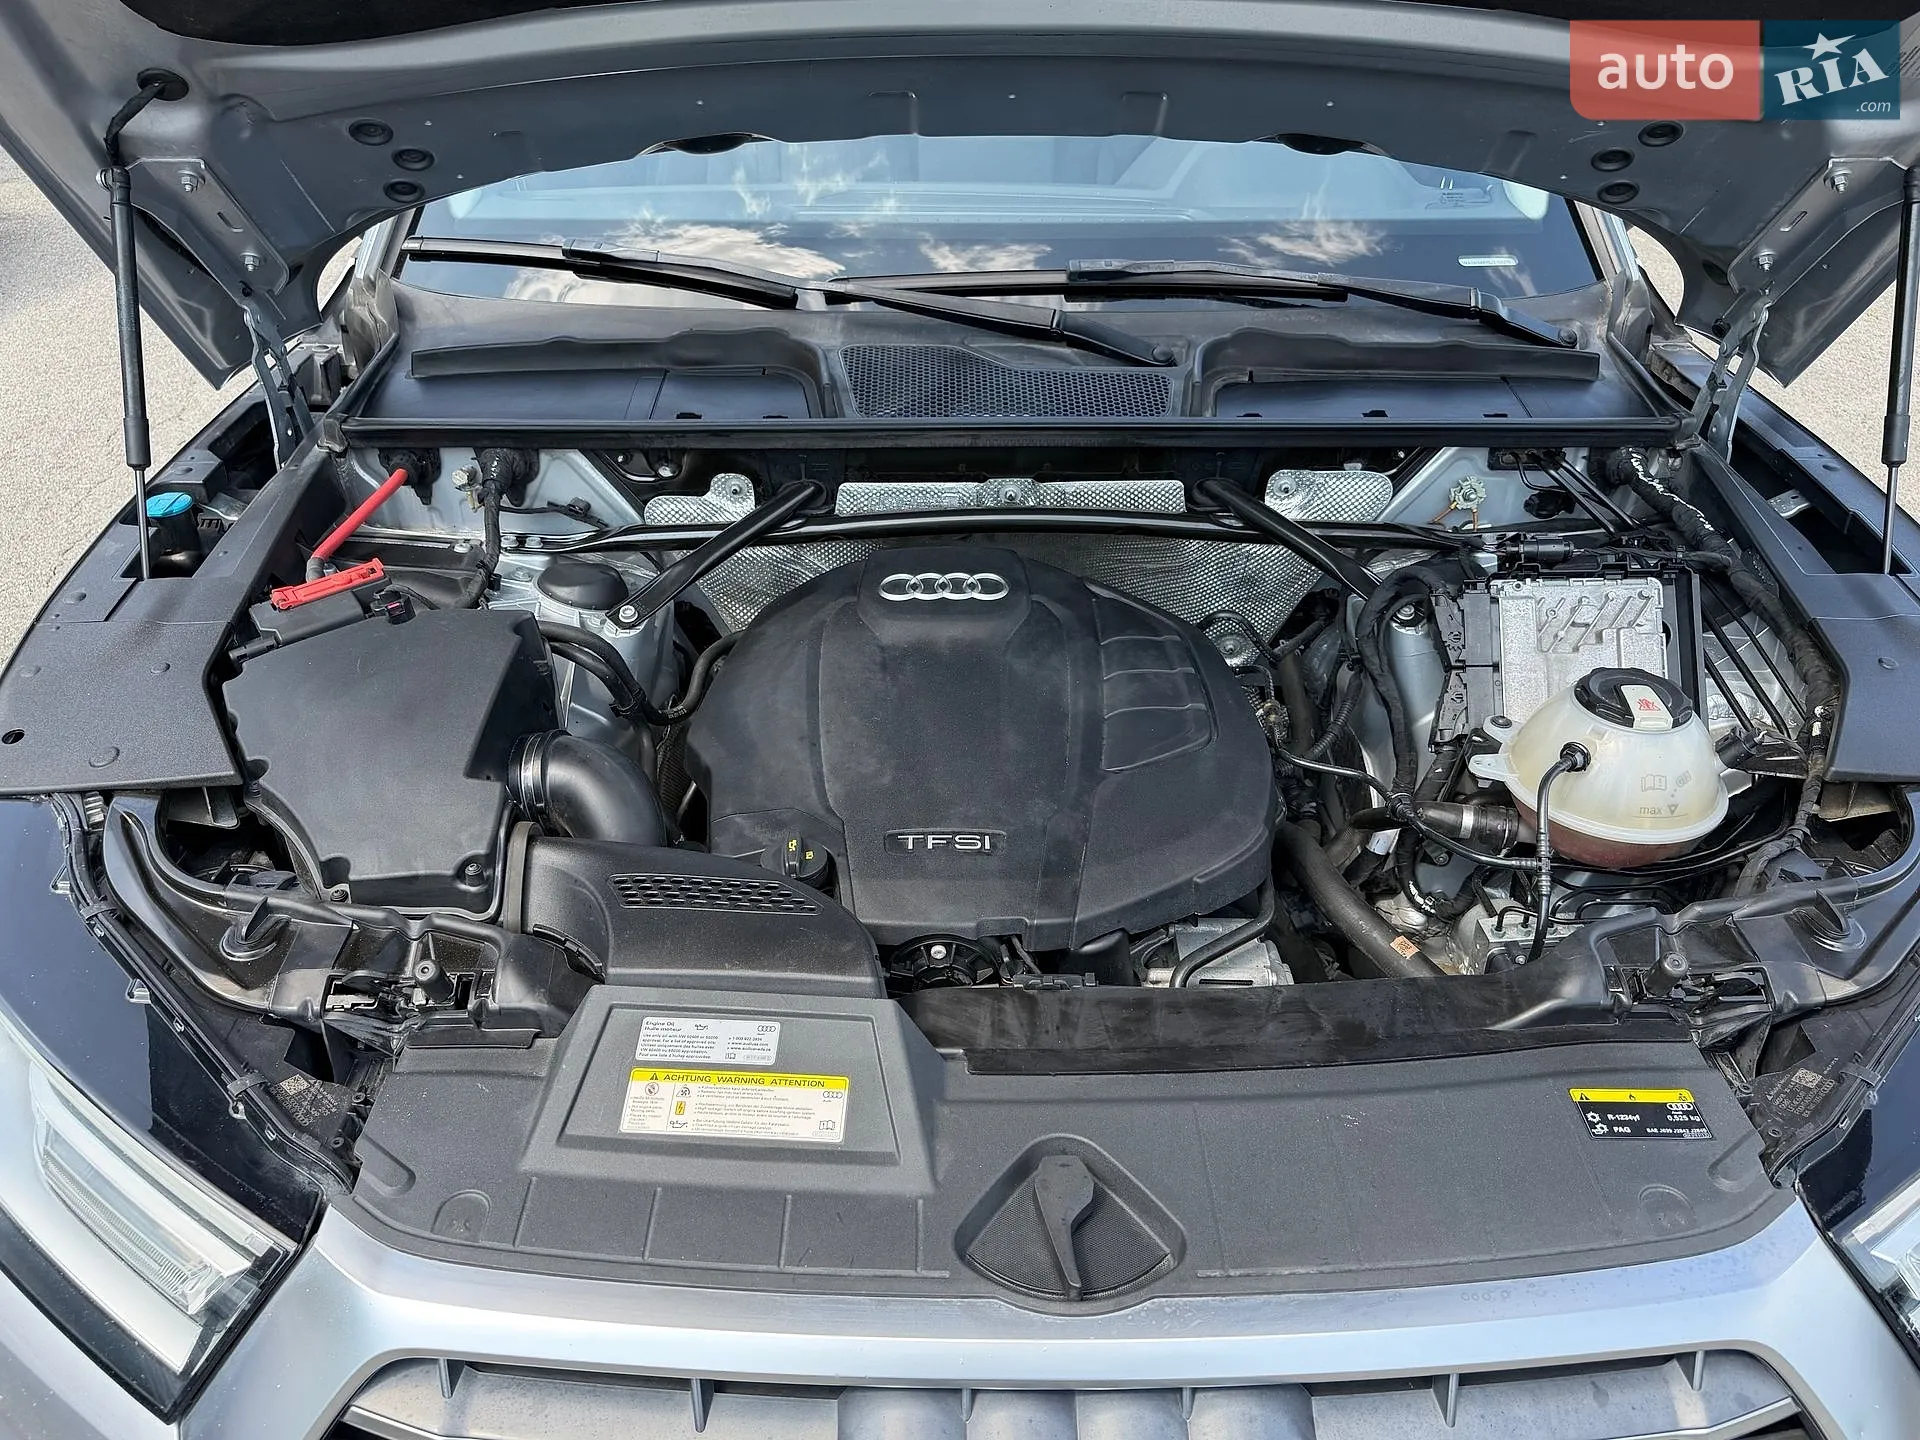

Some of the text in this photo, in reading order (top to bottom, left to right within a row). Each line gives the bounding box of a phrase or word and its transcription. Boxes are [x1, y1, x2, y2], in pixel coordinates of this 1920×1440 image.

[1639, 805, 1663, 815] max
[898, 835, 991, 850] TFSI
[664, 1074, 825, 1088] ACHTUNG WARNING ATTENTION
